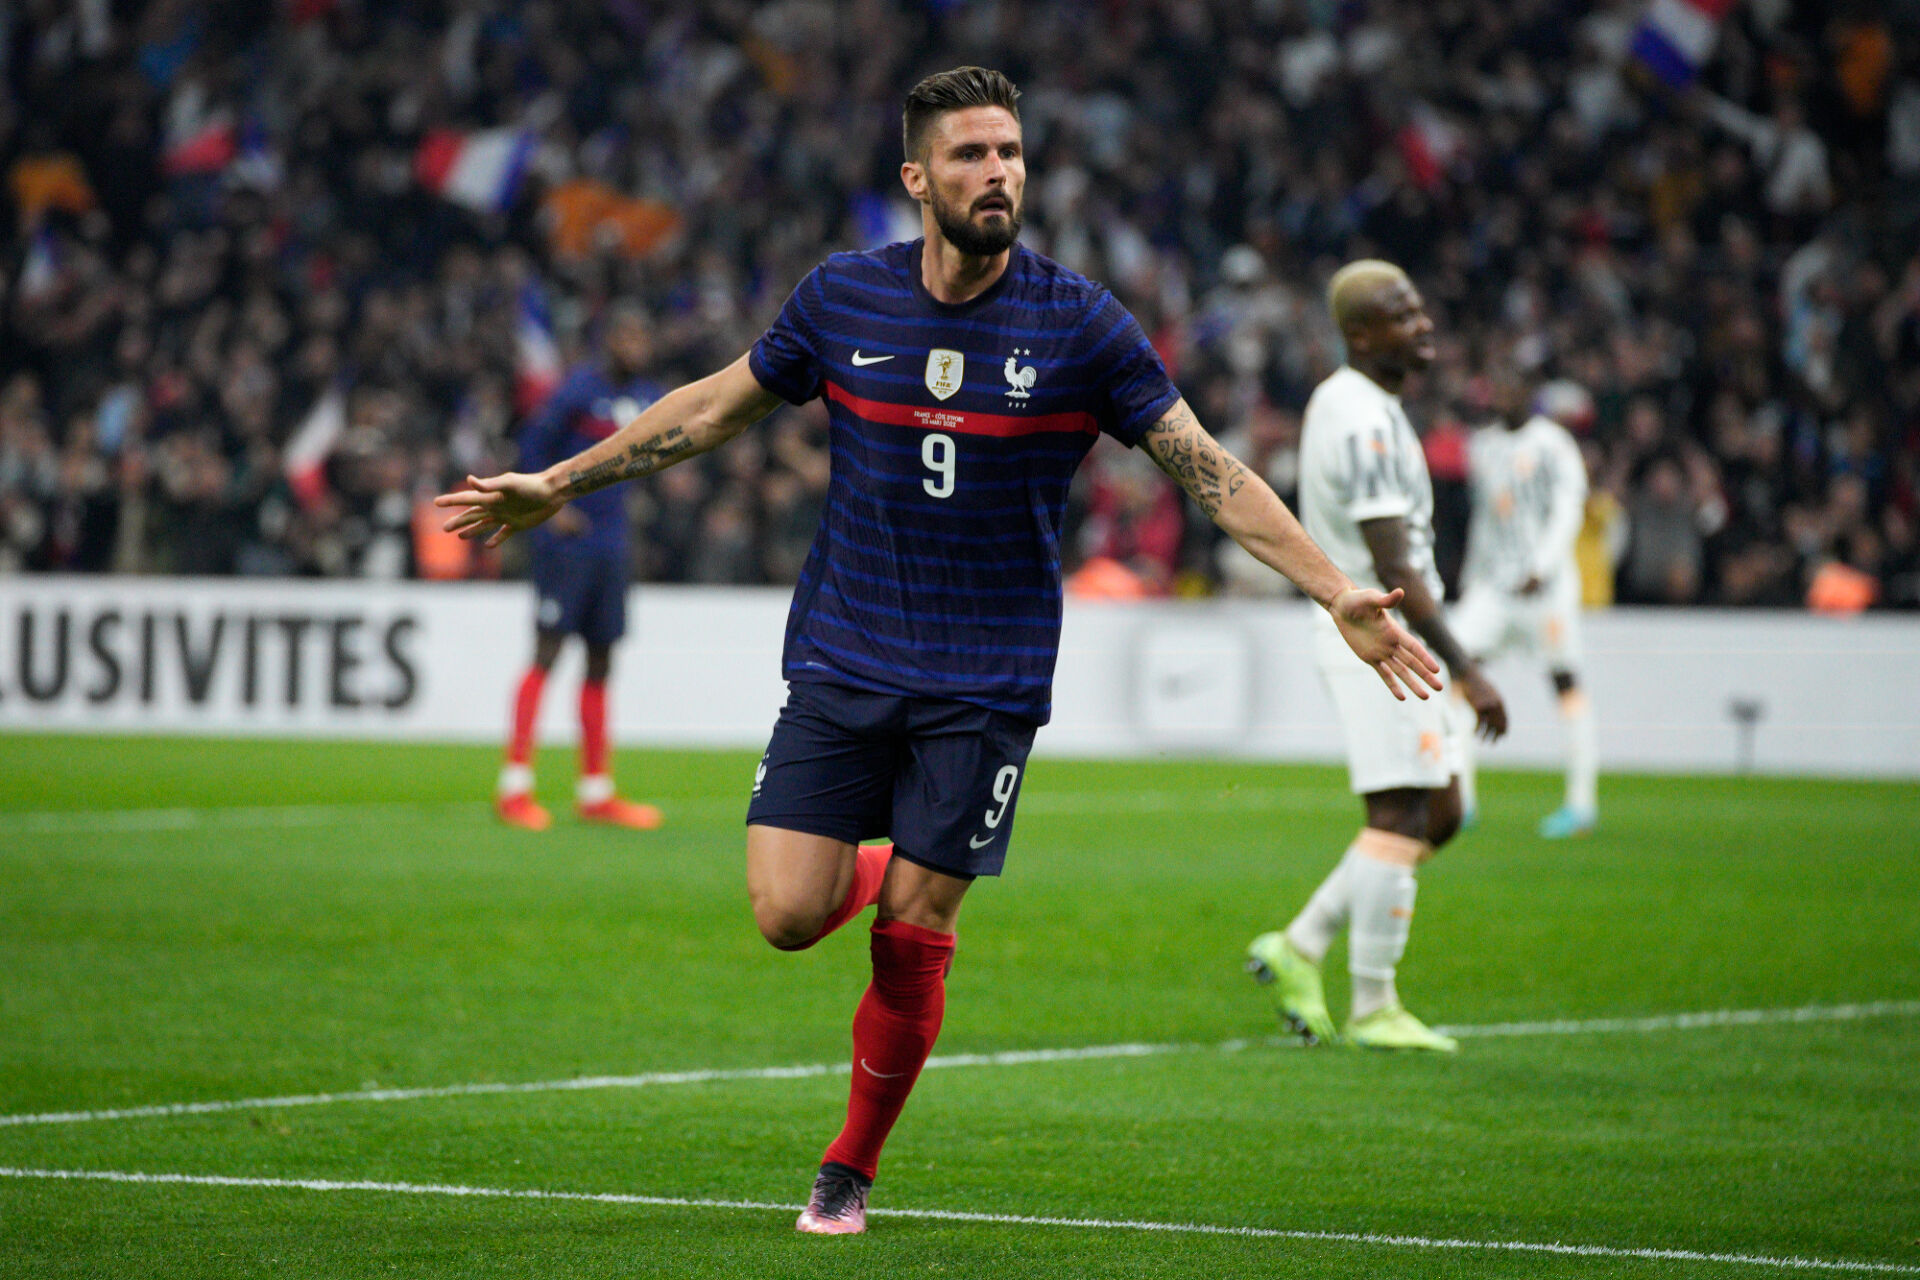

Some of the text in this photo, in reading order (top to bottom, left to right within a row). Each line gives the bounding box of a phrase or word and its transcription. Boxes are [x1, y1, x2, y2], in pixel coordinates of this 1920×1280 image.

[921, 433, 956, 499] 9
[0, 608, 417, 707] USIVITES
[984, 764, 1018, 829] 9
